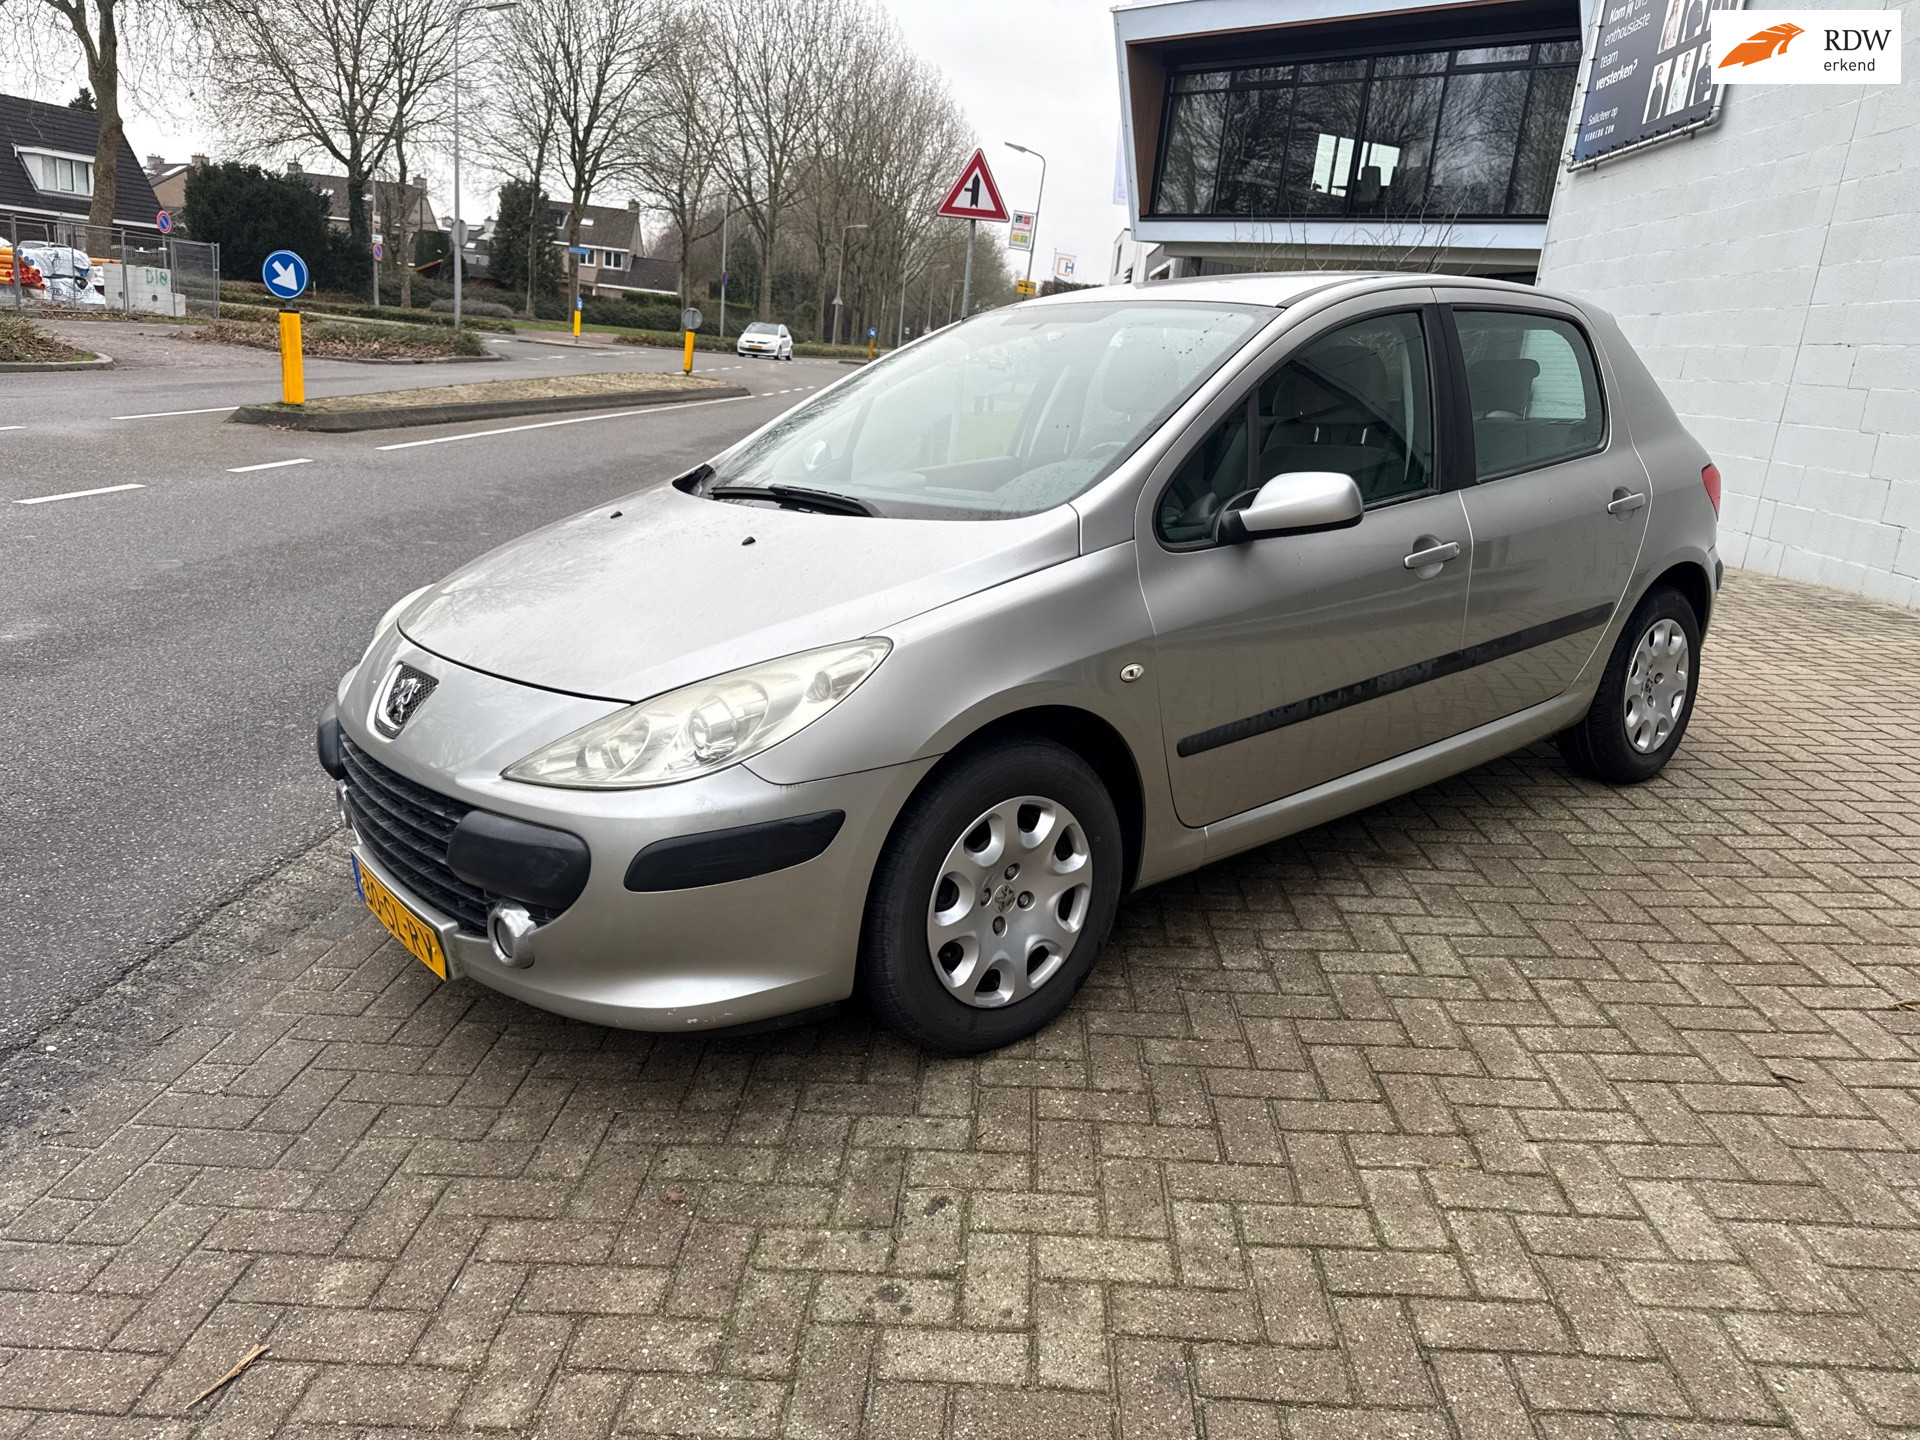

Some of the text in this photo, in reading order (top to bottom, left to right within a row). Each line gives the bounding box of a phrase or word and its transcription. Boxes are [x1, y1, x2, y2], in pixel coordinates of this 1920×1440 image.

[1608, 6, 1626, 25] Kom
[1625, 0, 1634, 20] jij
[1604, 12, 1651, 47] enthousiaste
[1600, 50, 1619, 69] team
[1595, 58, 1639, 91] versterken?
[1587, 107, 1619, 127] Solliciteer op
[362, 872, 434, 962] 30-SL-RV
